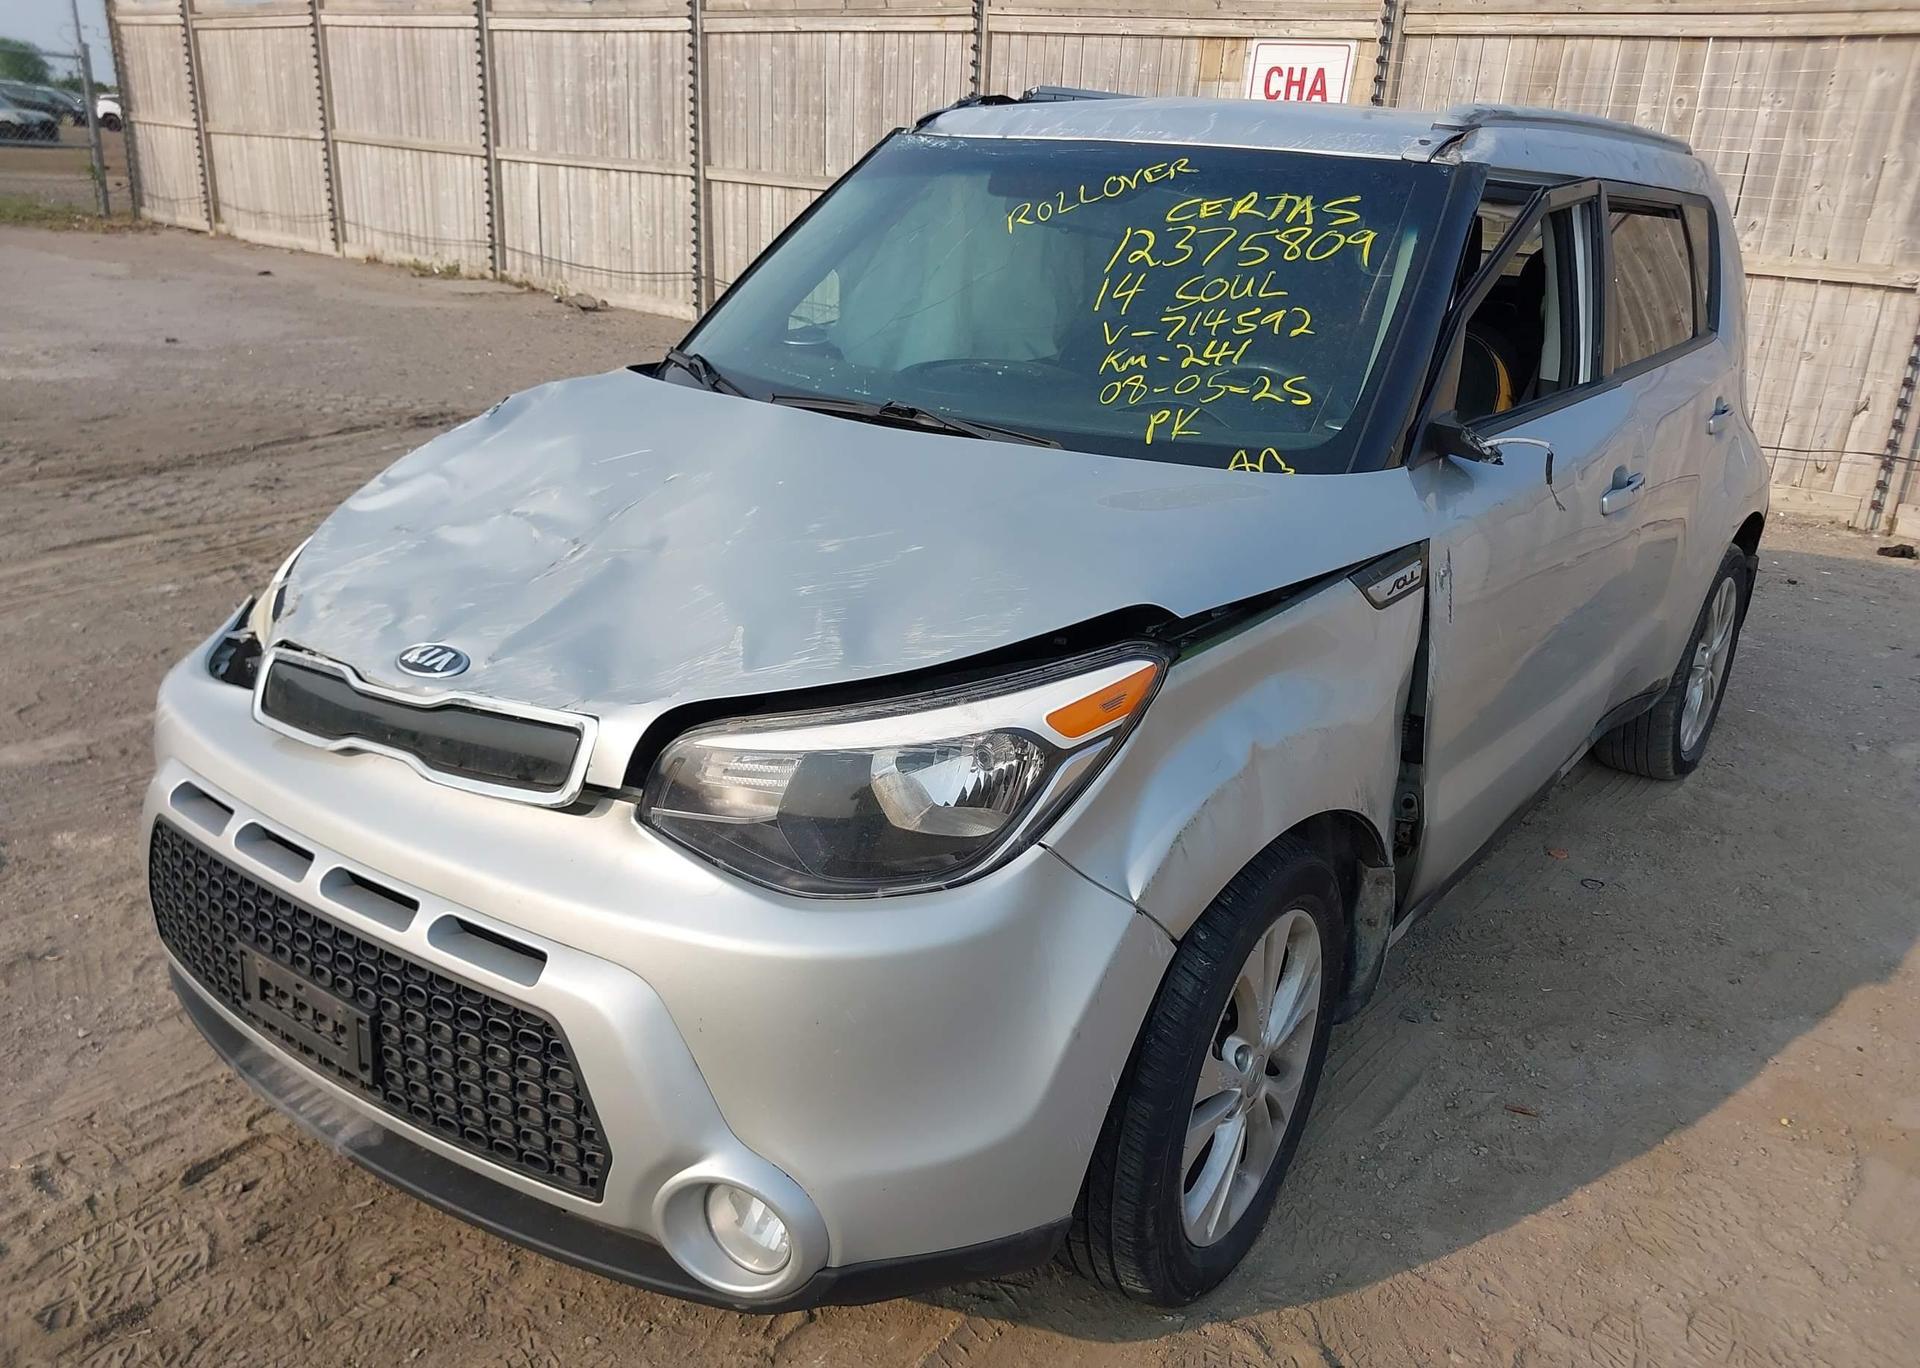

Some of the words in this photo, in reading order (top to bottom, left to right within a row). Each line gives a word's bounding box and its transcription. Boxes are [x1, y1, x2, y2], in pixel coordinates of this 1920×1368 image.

[1264, 66, 1328, 102] CHA
[1007, 157, 1200, 235] ROLLOVER
[1165, 191, 1363, 226] CERTAS
[1103, 226, 1378, 275] 12375809
[1094, 271, 1147, 315] 14
[1164, 270, 1289, 313] SOUL
[1144, 408, 1201, 444] PK
[400, 646, 457, 672] KIA
